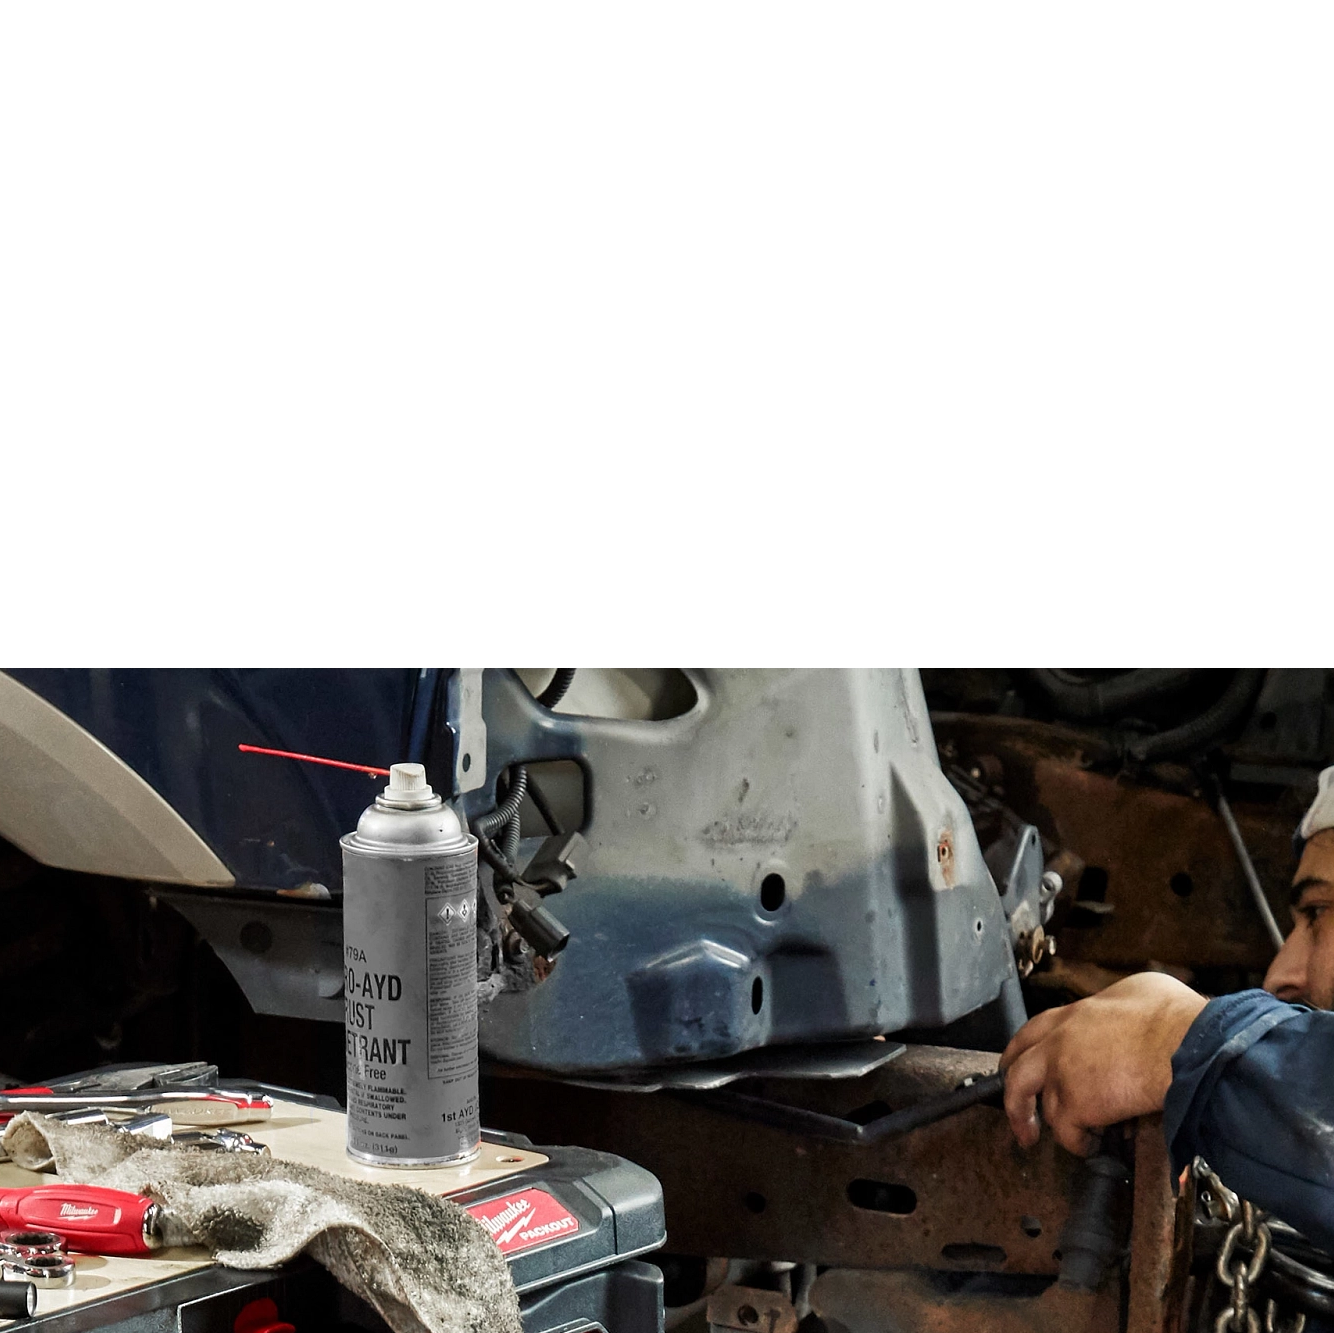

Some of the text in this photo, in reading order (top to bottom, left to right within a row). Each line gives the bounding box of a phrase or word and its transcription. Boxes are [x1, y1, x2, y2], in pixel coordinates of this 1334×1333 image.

[364, 1064, 386, 1080] Free
[367, 1084, 407, 1095] FLAMMABLE.
[367, 1093, 407, 1104] SWALLOWED.
[383, 1111, 407, 1121] UNDER
[441, 1105, 474, 1123] 1st AYD
[59, 1202, 99, 1217] Milwaukee
[474, 1198, 532, 1236] ilwaukee
[518, 1217, 575, 1241] PACKOUT
